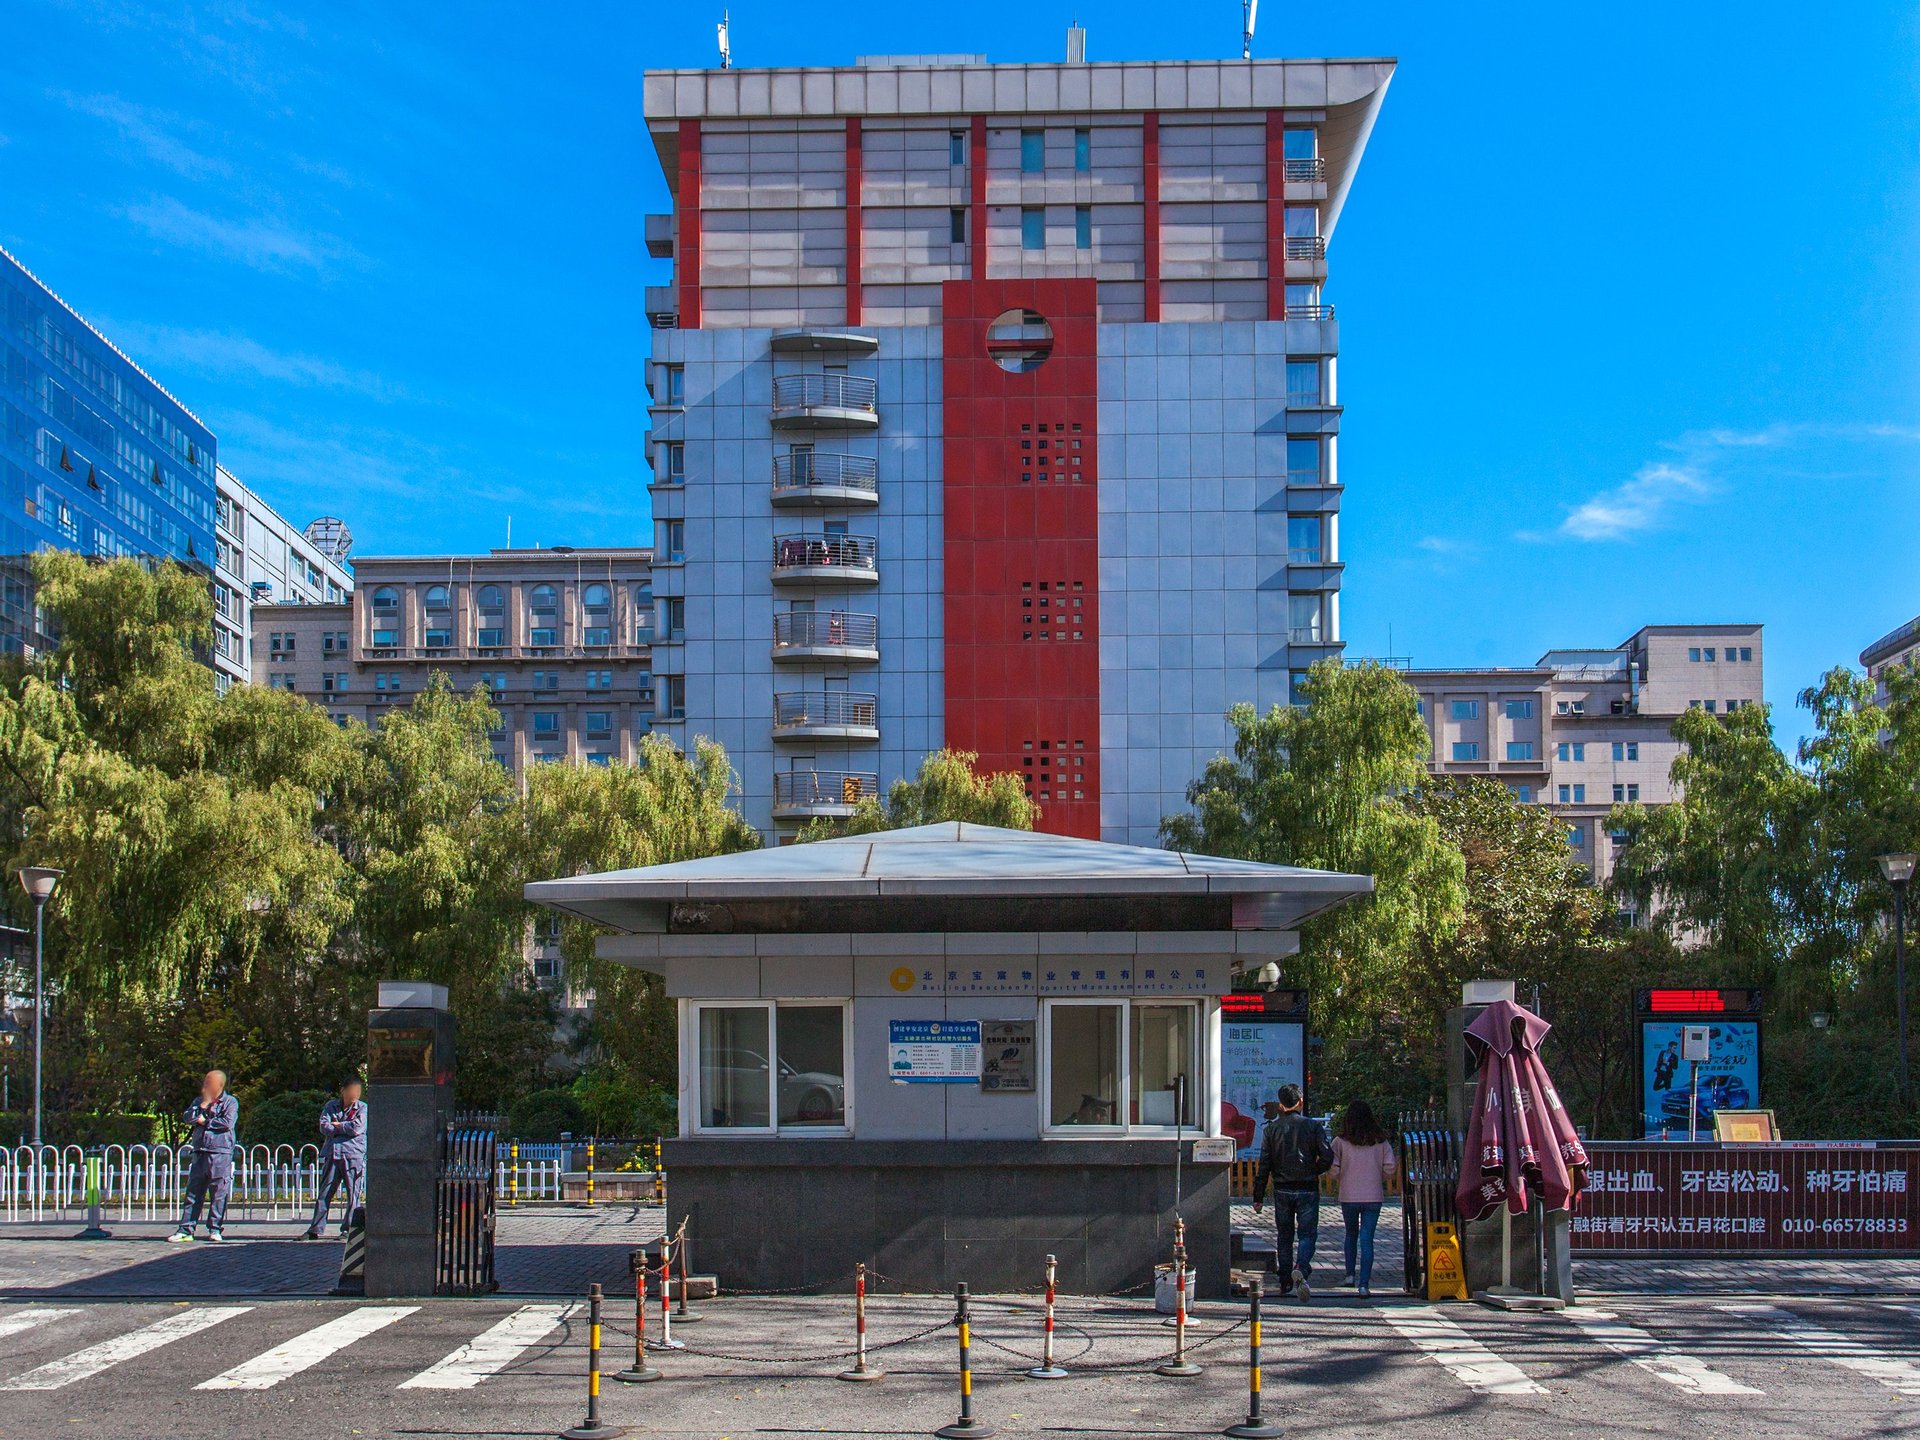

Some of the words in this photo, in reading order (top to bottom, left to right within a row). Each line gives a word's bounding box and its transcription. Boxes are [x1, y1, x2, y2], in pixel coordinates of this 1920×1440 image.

[1568, 1216, 1766, 1234] 融街看牙只认五月花口腔
[1782, 1218, 1908, 1234] 010-66578833
